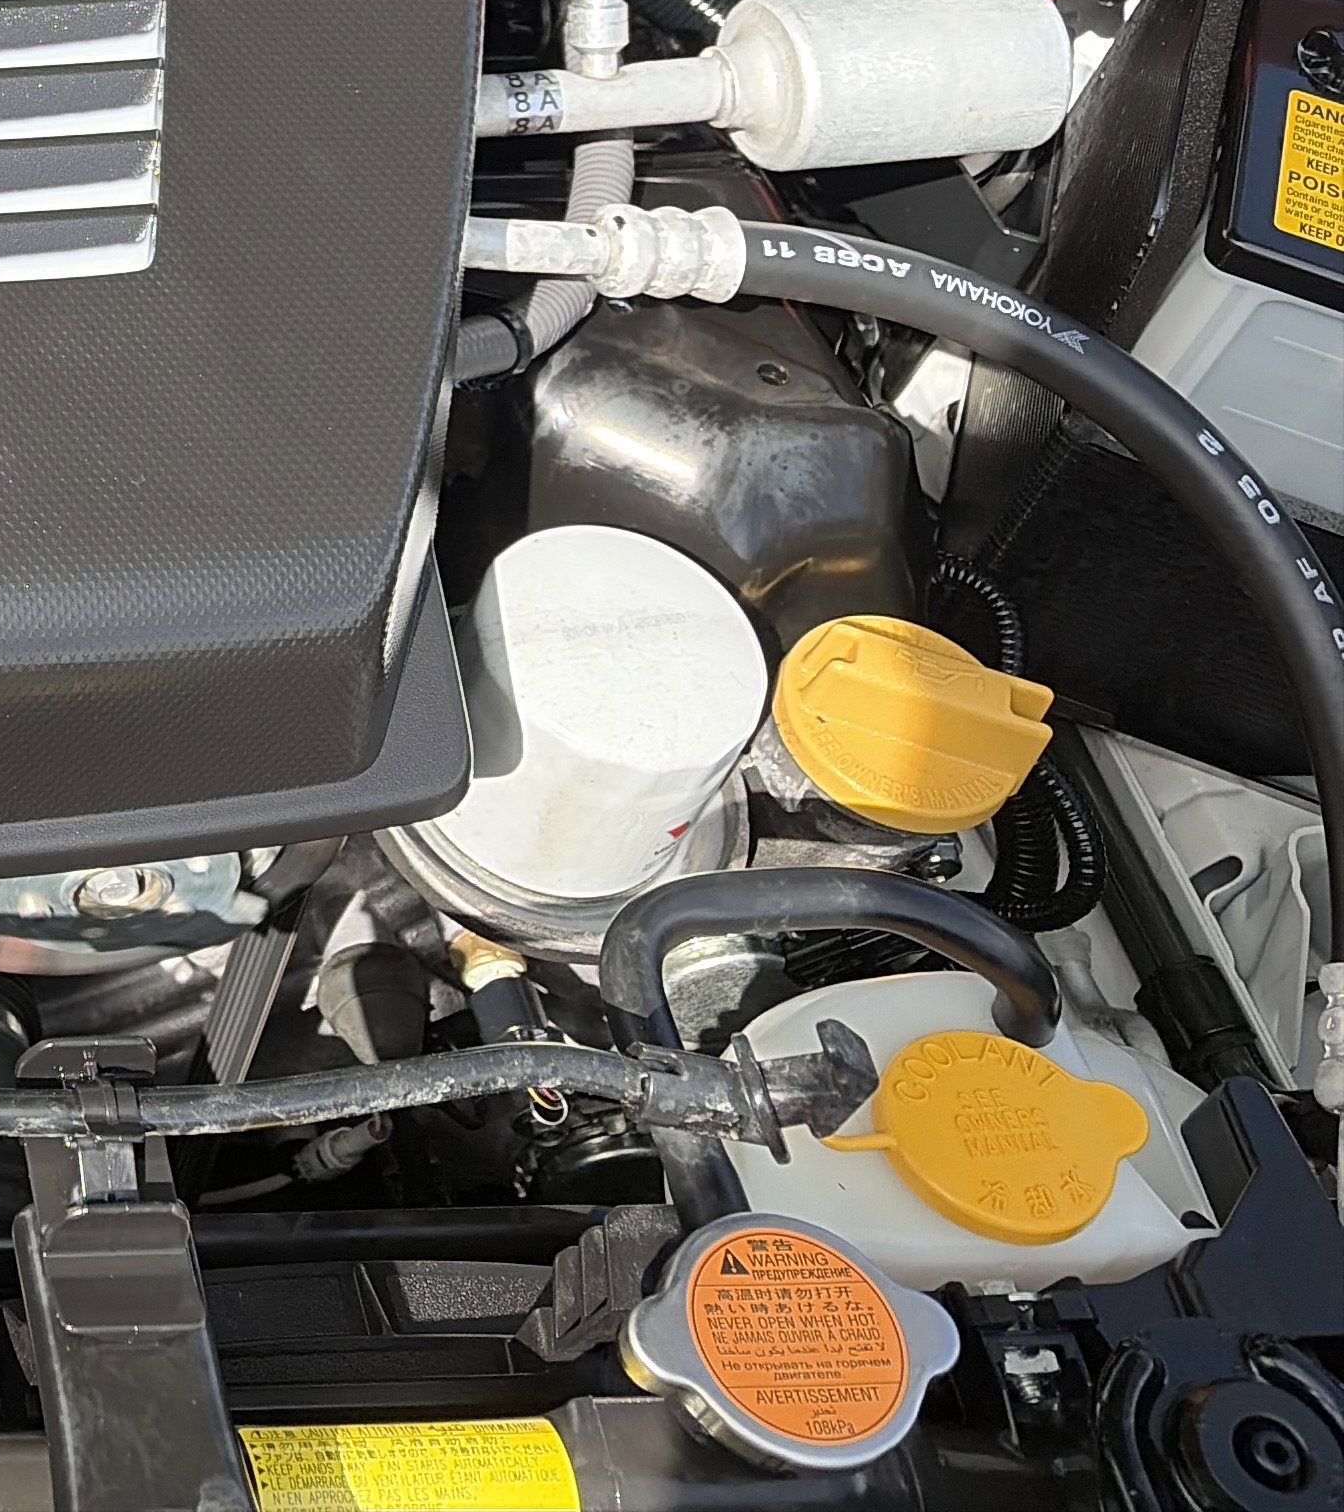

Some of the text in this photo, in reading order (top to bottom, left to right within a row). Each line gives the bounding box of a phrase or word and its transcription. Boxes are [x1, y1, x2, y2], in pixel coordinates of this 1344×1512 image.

[1297, 98, 1344, 126] DAN
[1293, 132, 1306, 143] Do
[1308, 138, 1324, 149] not
[1294, 125, 1335, 144] explode.
[1307, 157, 1340, 176] KEEP
[1288, 170, 1344, 199] POIS
[1285, 197, 1309, 211] eyes
[1311, 205, 1322, 215] or
[1287, 186, 1329, 208] Contains
[1284, 206, 1314, 222] water
[1317, 218, 1336, 230] and
[1299, 221, 1333, 242] KEEP
[930, 268, 1053, 335] YOKOHAMA
[838, 752, 923, 807] OWNER'S
[927, 774, 1004, 810] MANUAL
[893, 1037, 1069, 1102] COOLANT
[956, 1088, 1009, 1113] SEE
[962, 1130, 1061, 1159] MANUAL
[747, 1239, 794, 1252] 警告
[747, 1253, 829, 1267] WARNING
[751, 1267, 853, 1282] ПРЕДУПРЕЖДЕНИЕ
[715, 1287, 853, 1301] 高温时请勿打开
[707, 1316, 753, 1330] NEVER
[758, 1316, 795, 1329] OPEN
[800, 1315, 843, 1328] WHEN
[712, 1332, 728, 1344] NE
[732, 1330, 776, 1345] JAMAIS
[779, 1329, 824, 1344] OUVRIR
[722, 1359, 892, 1372] Не открывать на горячем
[756, 1387, 881, 1404] AVERTISSEMENT
[357, 1425, 422, 1437] ATTENTION
[806, 1419, 857, 1436] 108kPa
[266, 1464, 293, 1476] KEEP
[300, 1463, 334, 1475] HANDS
[380, 1460, 401, 1472] FAN
[406, 1458, 448, 1471] STARTS
[269, 1477, 283, 1491] LE
[273, 1491, 302, 1506] N'EN
[379, 1489, 402, 1504] PAS
[407, 1487, 430, 1502] LES
